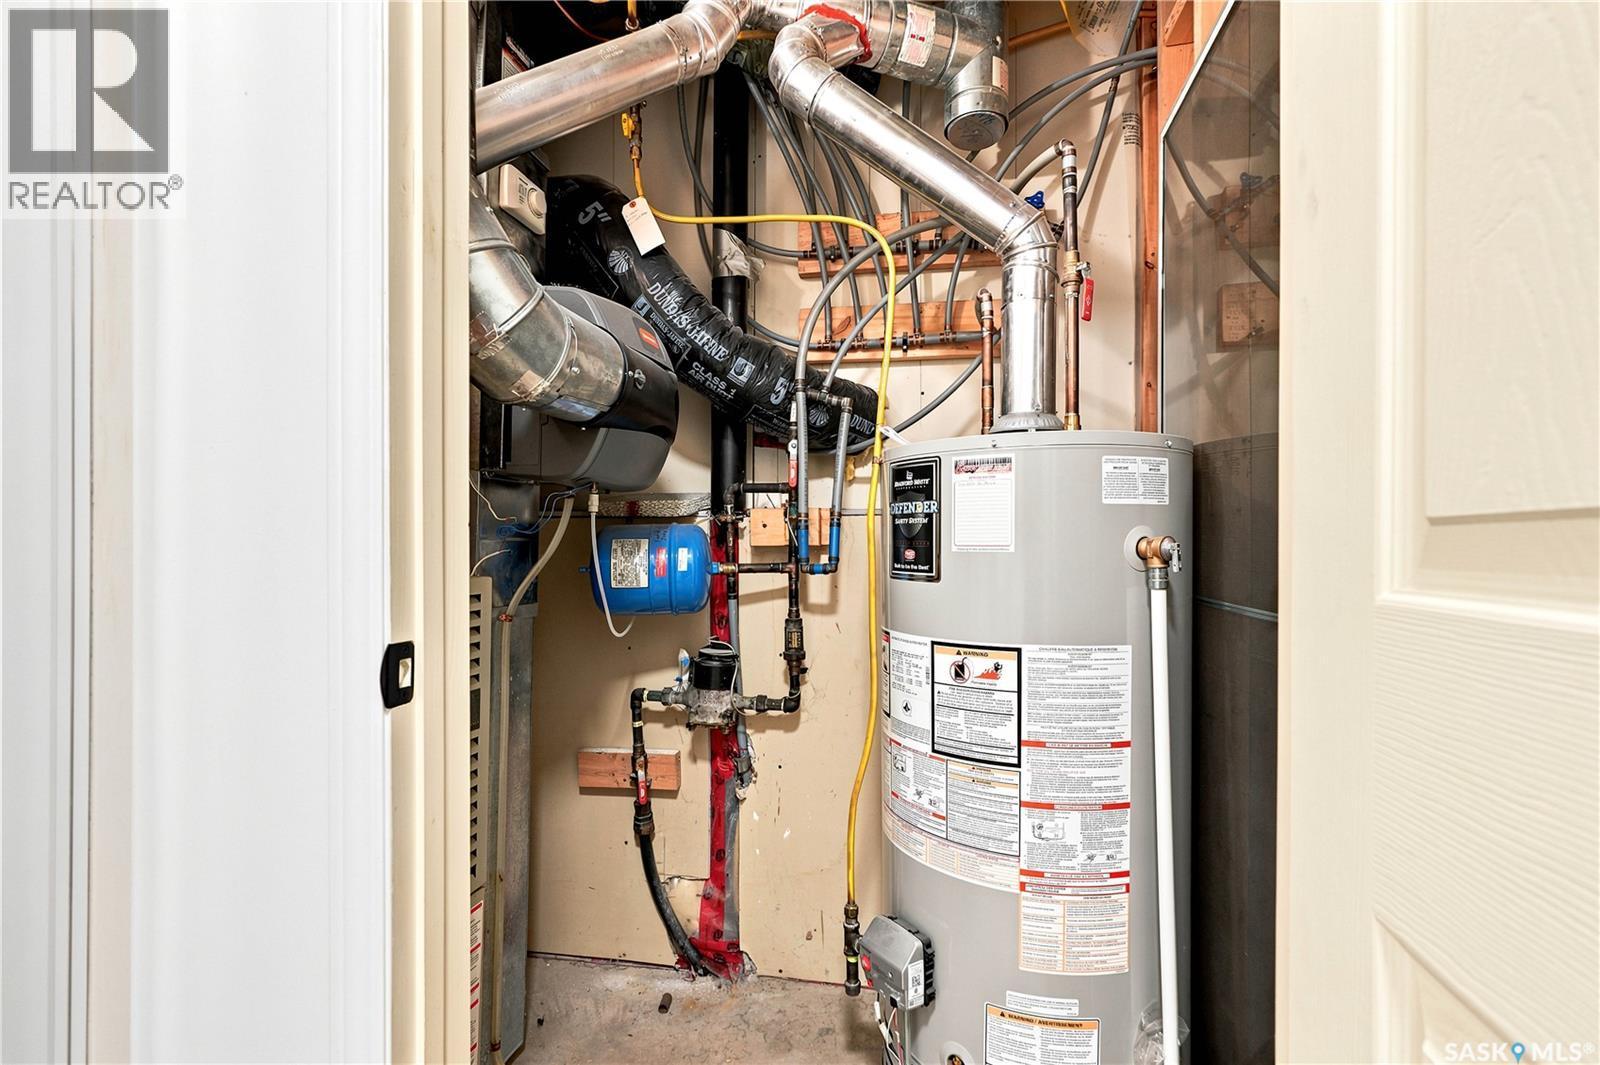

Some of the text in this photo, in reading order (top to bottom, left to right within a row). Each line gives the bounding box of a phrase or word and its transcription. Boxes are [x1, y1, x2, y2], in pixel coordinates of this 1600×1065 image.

[578, 201, 612, 225] 5"
[688, 369, 705, 384] AIR
[692, 361, 727, 390] CLASS
[890, 501, 939, 515] DEFENDER
[963, 650, 989, 658] WARNING
[1008, 1013, 1034, 1023] WARNING
